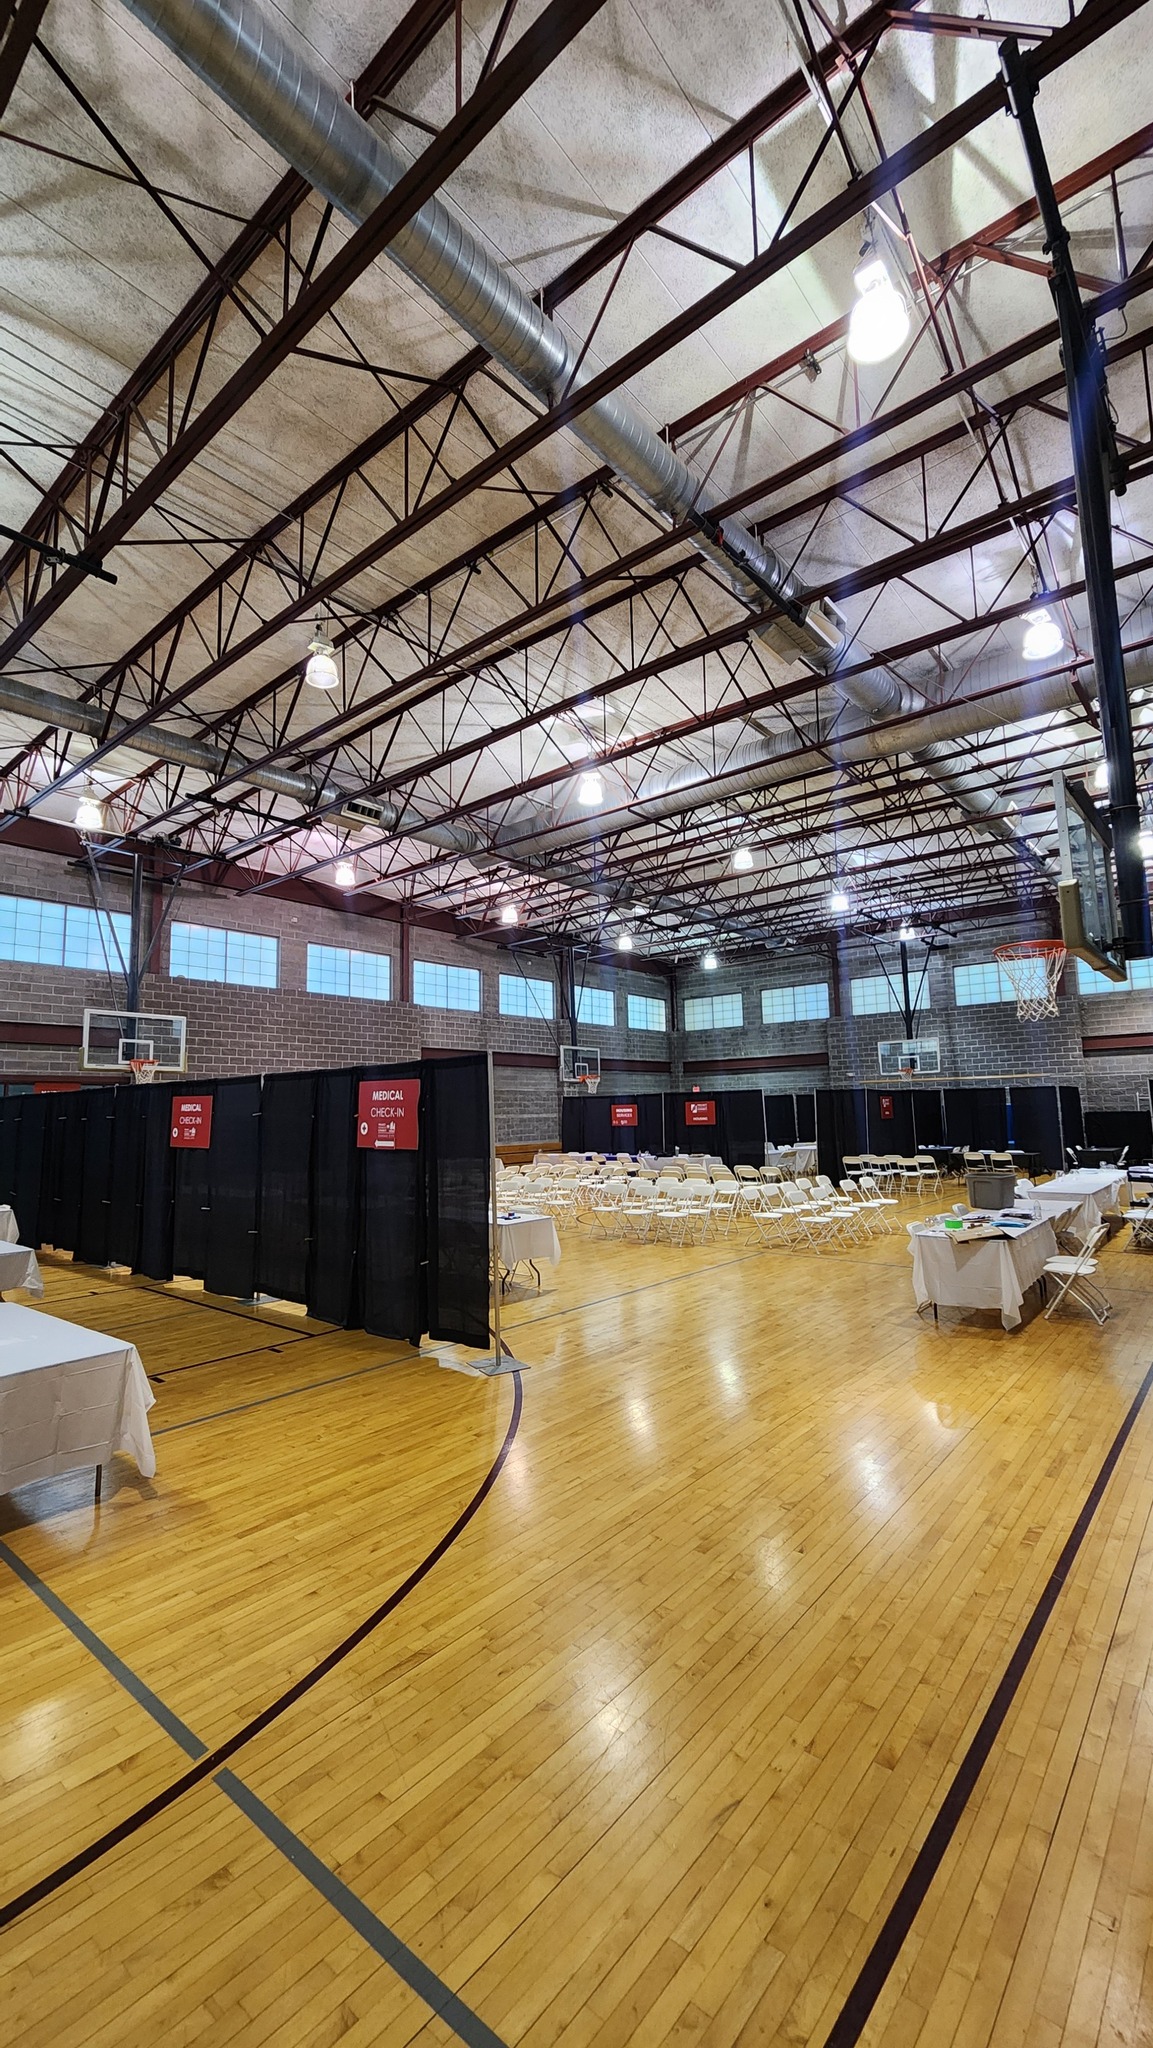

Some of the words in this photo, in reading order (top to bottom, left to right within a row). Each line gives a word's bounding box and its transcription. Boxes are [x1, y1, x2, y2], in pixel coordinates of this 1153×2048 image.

[372, 1090, 404, 1101] MEDICAL
[180, 1104, 202, 1112] MEDICAL
[370, 1107, 405, 1118] CHECK-IN
[179, 1116, 202, 1125] CHECK-IN
